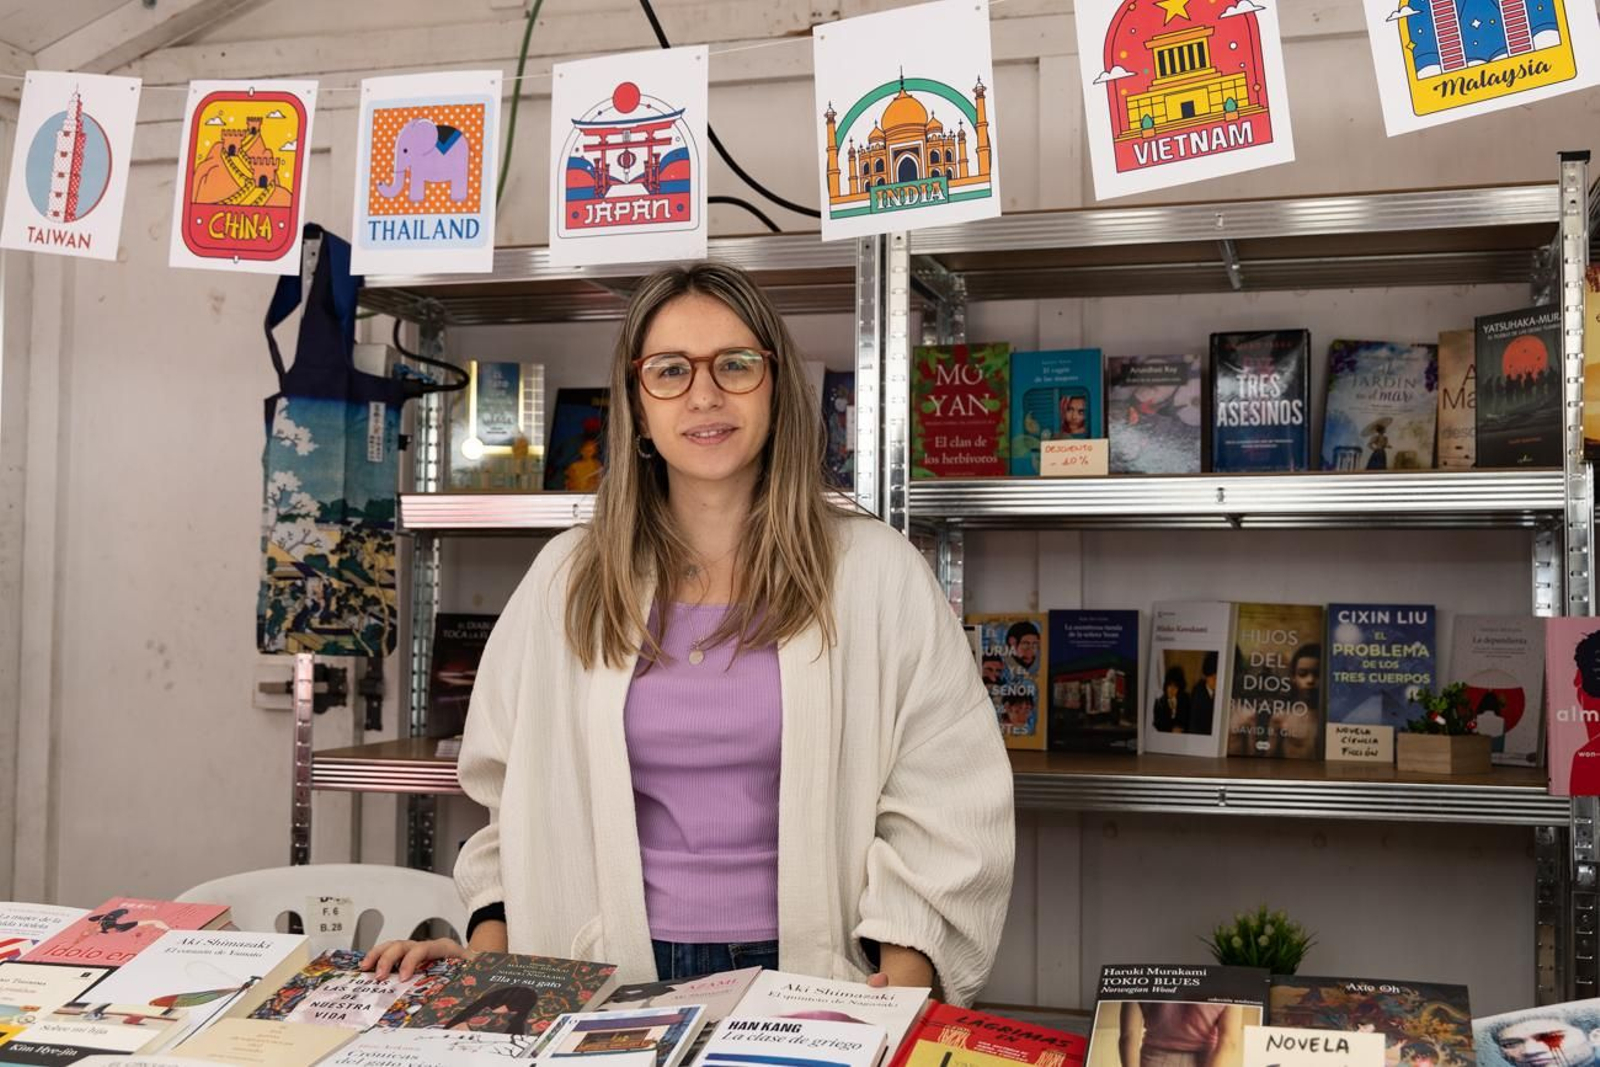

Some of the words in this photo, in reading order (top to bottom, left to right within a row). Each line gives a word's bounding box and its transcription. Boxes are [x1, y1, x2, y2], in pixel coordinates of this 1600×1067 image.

[1433, 57, 1552, 98] Malaysia
[1132, 122, 1254, 166] VIETNAM
[875, 181, 945, 210] INDIA
[583, 198, 671, 225] JAPAN
[208, 210, 272, 241] CHINA
[368, 218, 480, 242] THAILAND
[27, 225, 92, 250] TAIWAN
[935, 363, 983, 386] MO
[1236, 373, 1281, 399] TRES
[928, 393, 990, 417] YAN
[1217, 399, 1303, 427] ASESINOS
[935, 436, 947, 448] El
[949, 436, 972, 448] clan
[974, 436, 987, 448] de
[924, 453, 940, 465] los
[942, 452, 998, 465] herbívoros
[1338, 610, 1390, 625] CIXIN
[1397, 610, 1428, 625] LIU
[1241, 629, 1299, 645] HIJOS
[1374, 632, 1387, 641] EL
[1333, 643, 1430, 658] PROBLEMA
[1250, 652, 1287, 669] DEL
[1362, 660, 1377, 669] DE
[1379, 660, 1399, 669] LOS
[1243, 674, 1291, 692] DIOS
[1333, 671, 1365, 683] TRES
[1369, 672, 1431, 684] CUERPOS
[1336, 726, 1371, 735] NOVELA
[177, 937, 201, 946] Aki
[203, 937, 272, 950] Shimazaki
[1103, 967, 1144, 976] Haruki
[1147, 967, 1207, 977] Murakami
[323, 985, 345, 993] LAS
[352, 986, 396, 994] COSAS
[489, 975, 510, 983] Ella
[510, 978, 520, 986] y
[535, 981, 562, 989] gato
[1102, 977, 1149, 986] TOKIO
[1153, 977, 1200, 987] BLUES
[1346, 982, 1375, 993] Axie
[1379, 984, 1401, 994] Oh
[781, 983, 809, 993] Aki
[814, 987, 896, 1001] Shimazaki
[1101, 986, 1149, 994] Norwegian
[1151, 986, 1178, 994] Wood
[310, 1000, 371, 1011] NUESTRA
[783, 994, 828, 1004] quinteto
[314, 1012, 347, 1021] VIDA
[728, 1021, 760, 1031] HAN
[760, 1022, 802, 1034] KANG
[721, 1031, 747, 1041] La
[746, 1032, 786, 1044] clase
[788, 1034, 809, 1045] de
[810, 1036, 863, 1051] griego
[1266, 1034, 1349, 1054] NOVELA
[8, 1043, 34, 1052] Kim
[34, 1045, 78, 1057] Hye-jin
